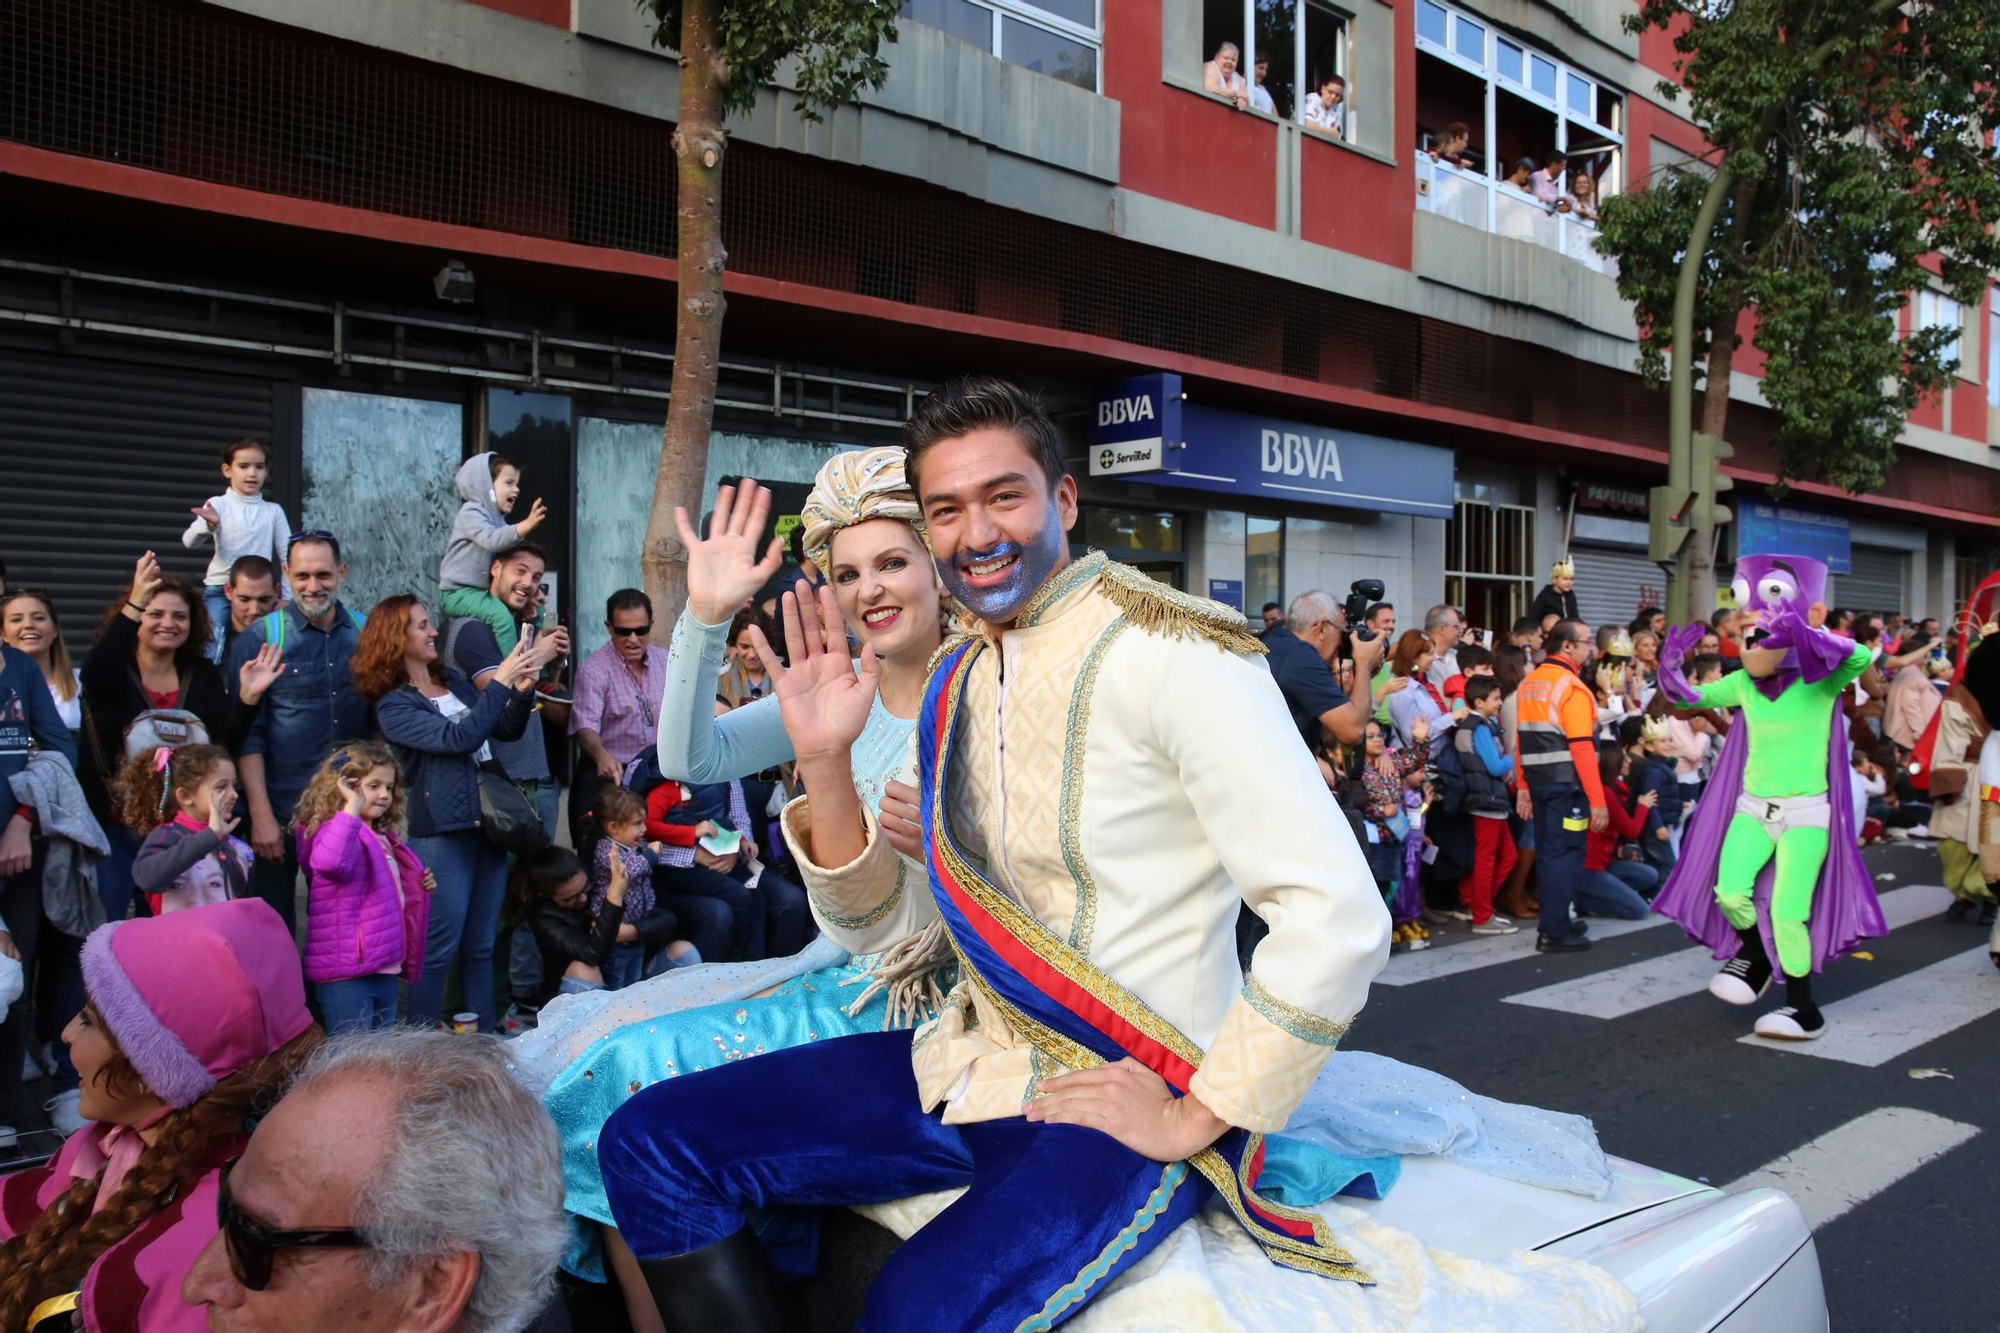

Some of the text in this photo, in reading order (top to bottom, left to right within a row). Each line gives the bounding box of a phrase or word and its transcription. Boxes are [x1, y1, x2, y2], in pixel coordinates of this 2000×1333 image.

[1098, 394, 1155, 427] BBVA
[1116, 448, 1152, 464] ServiRed
[1261, 429, 1343, 482] BBVA
[784, 518, 795, 526] EN
[1765, 801, 1780, 820] F
